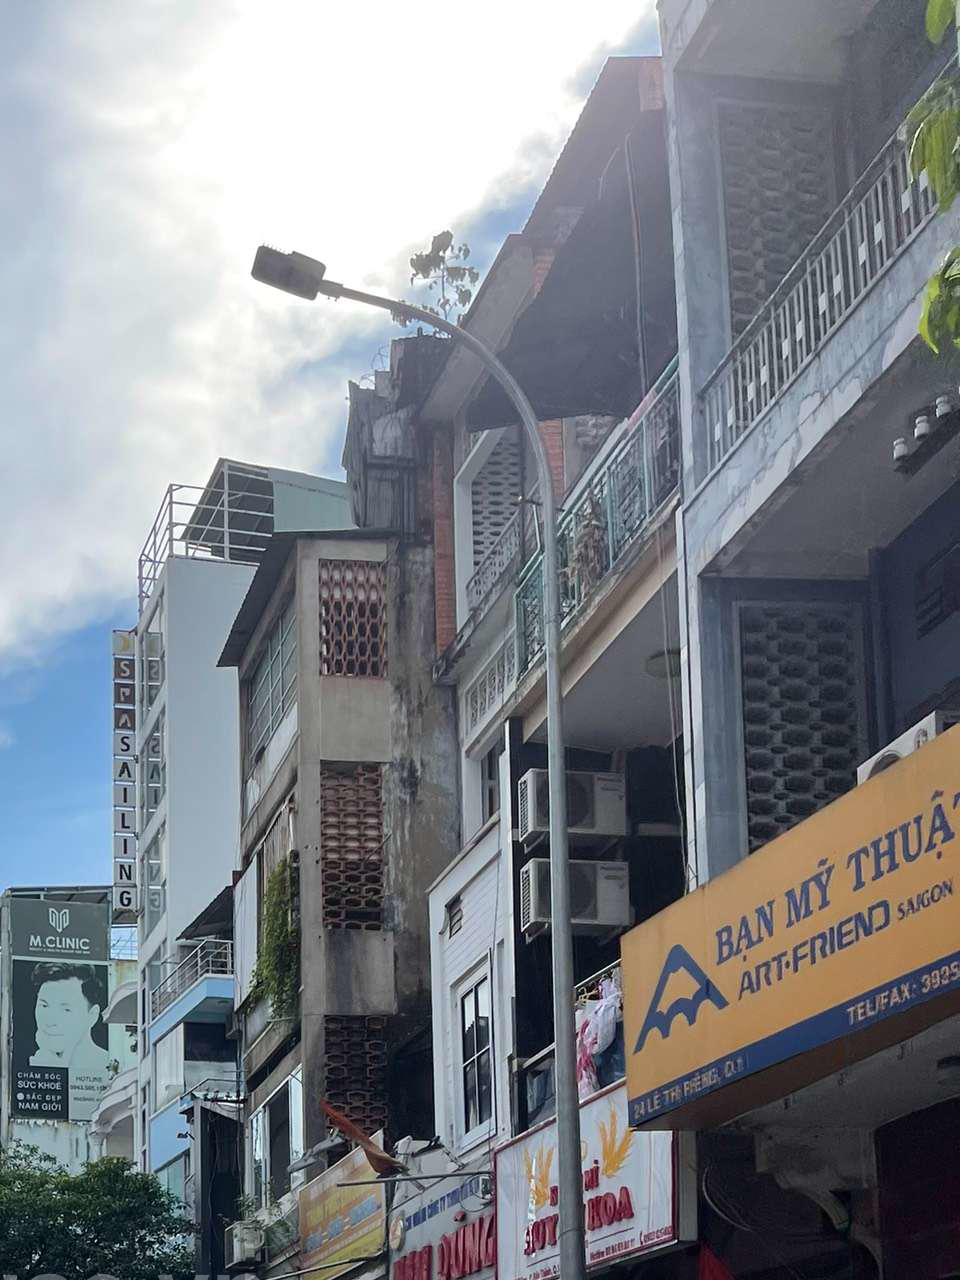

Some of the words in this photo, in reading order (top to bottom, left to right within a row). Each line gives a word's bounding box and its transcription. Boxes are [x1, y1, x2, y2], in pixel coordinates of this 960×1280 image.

[119, 735, 133, 908] SAILING
[784, 857, 835, 929] MỸ
[897, 877, 954, 921] SAIGON
[29, 934, 91, 950] M.CLINIC
[18, 1102, 39, 1111] NAM
